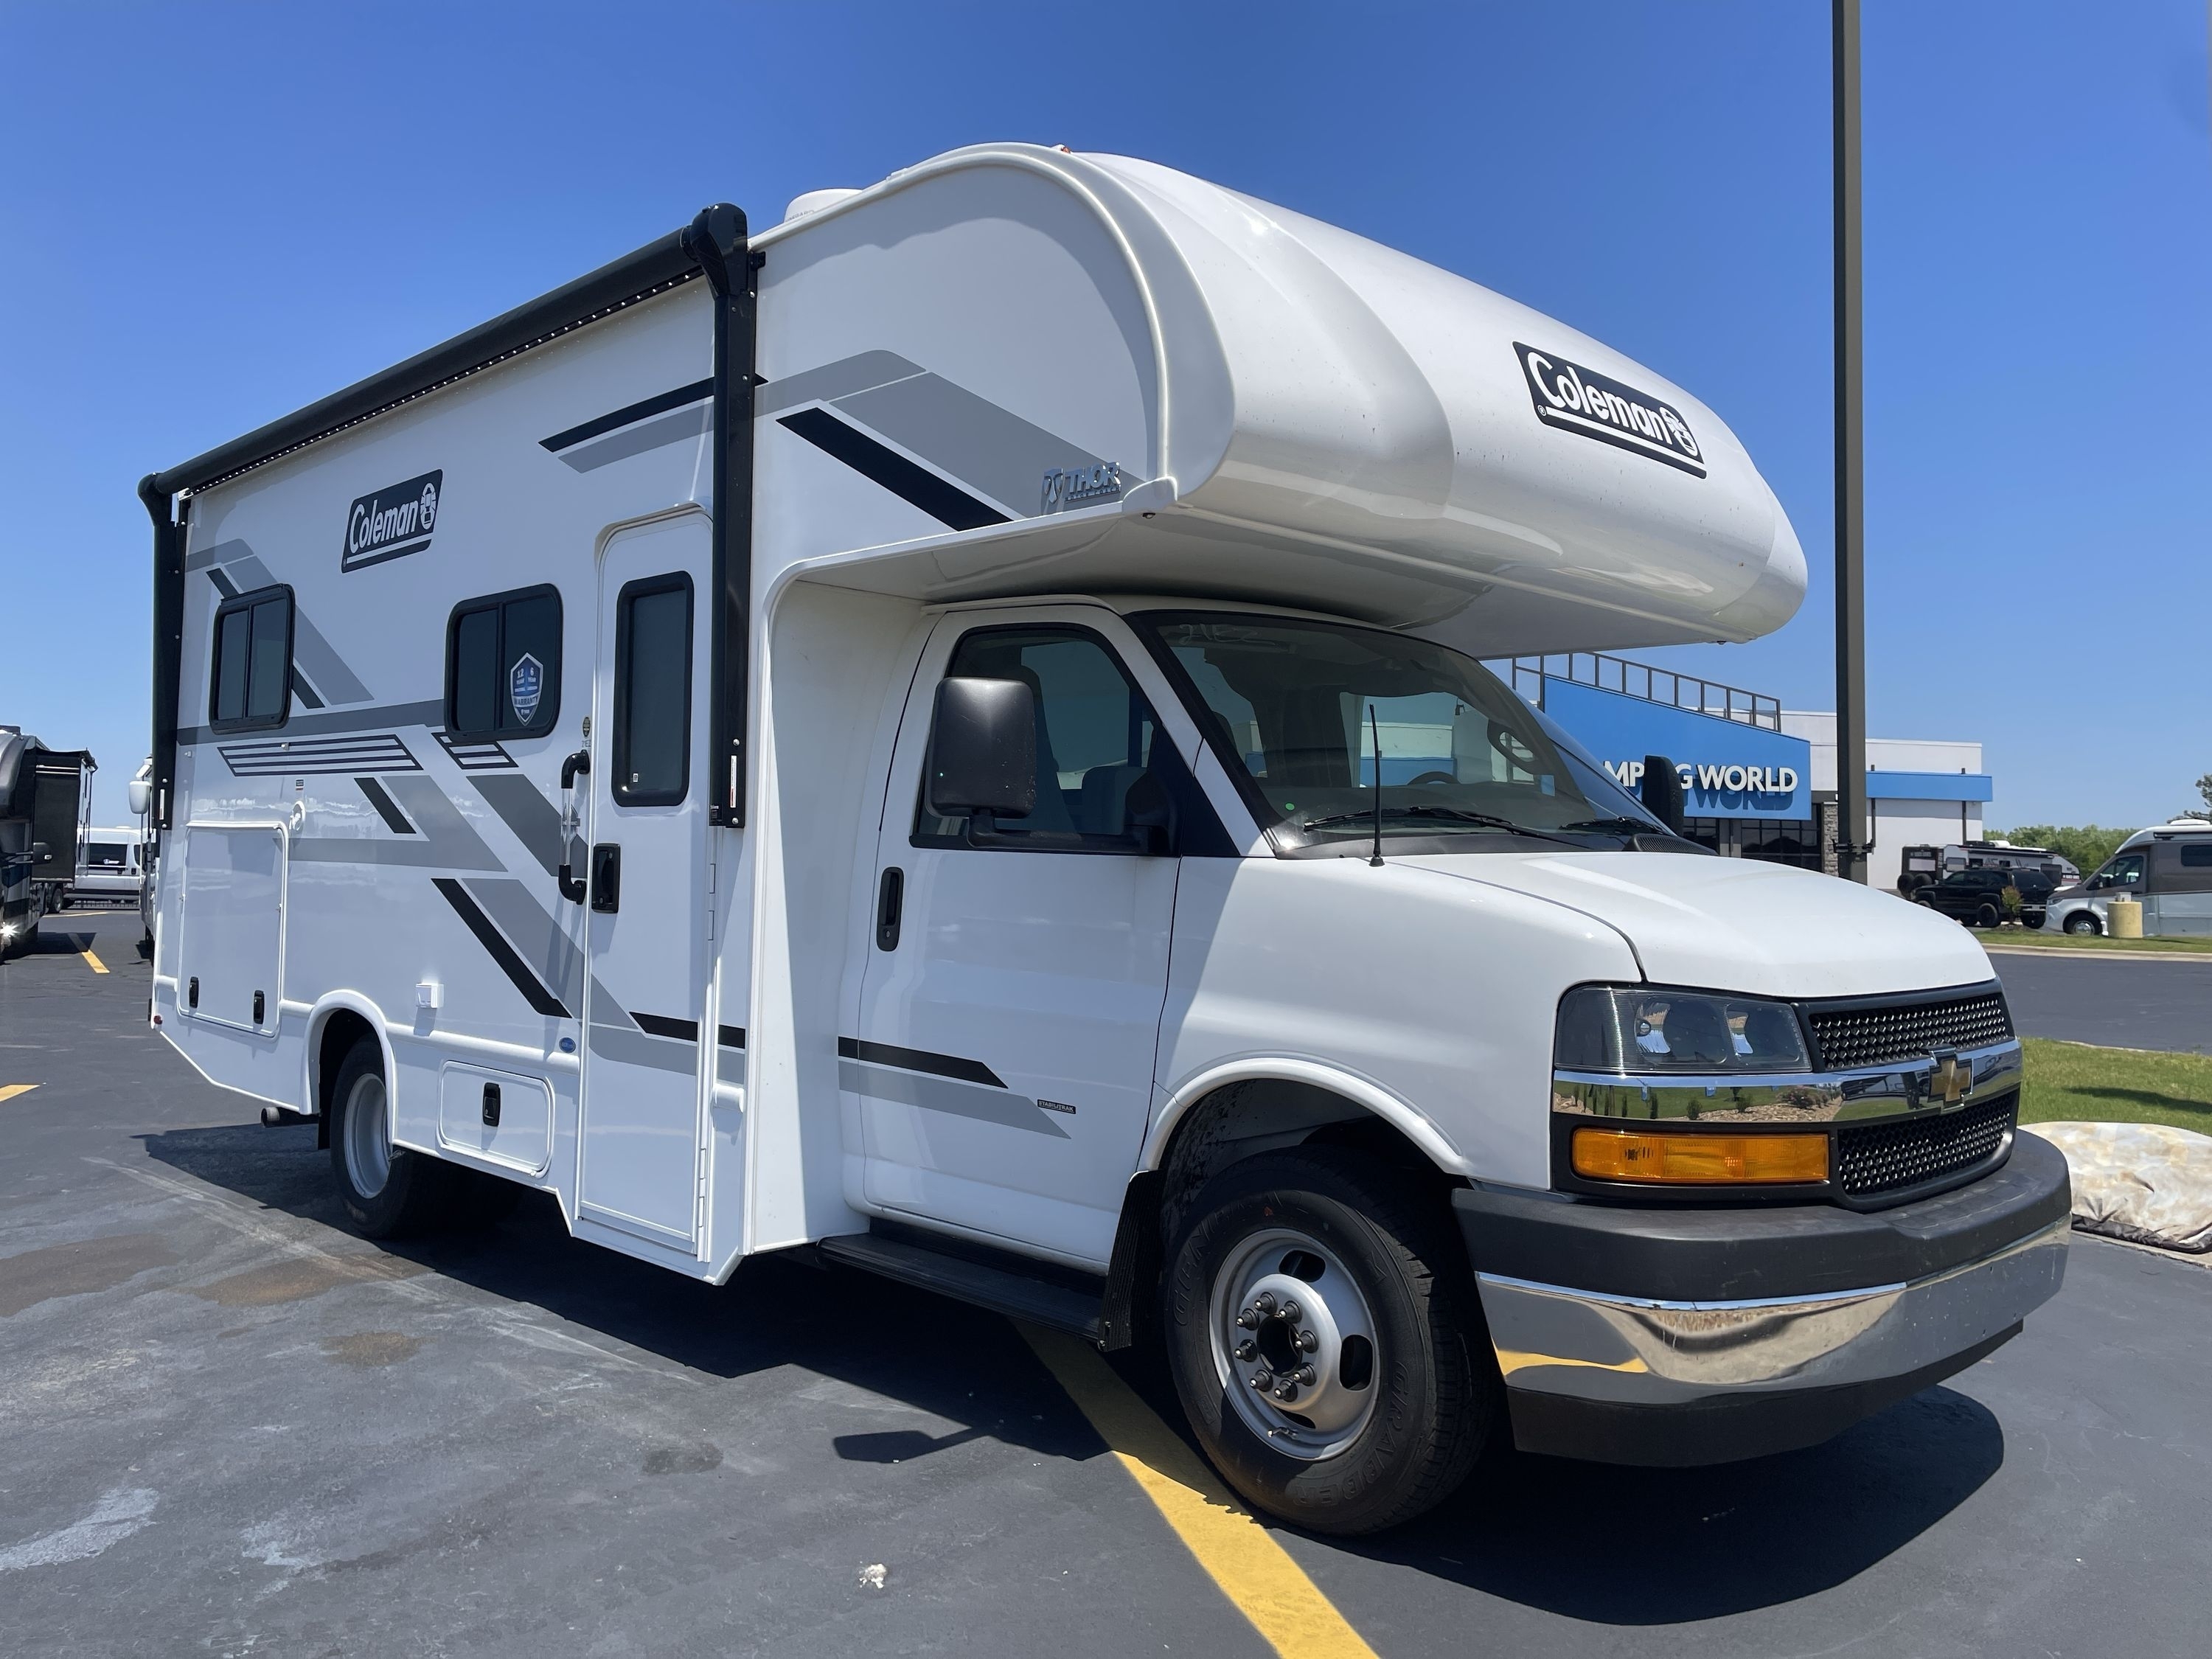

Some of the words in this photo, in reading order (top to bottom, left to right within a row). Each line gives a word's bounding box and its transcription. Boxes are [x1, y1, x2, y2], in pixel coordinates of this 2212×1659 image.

[1527, 352, 1673, 445] Coleman
[1065, 462, 1121, 494] THOR
[349, 499, 419, 553] Coleman
[517, 668, 524, 678] 12
[530, 667, 535, 676] 6
[1697, 764, 1798, 793] WORLD
[1292, 1361, 1410, 1506] GRABBER
